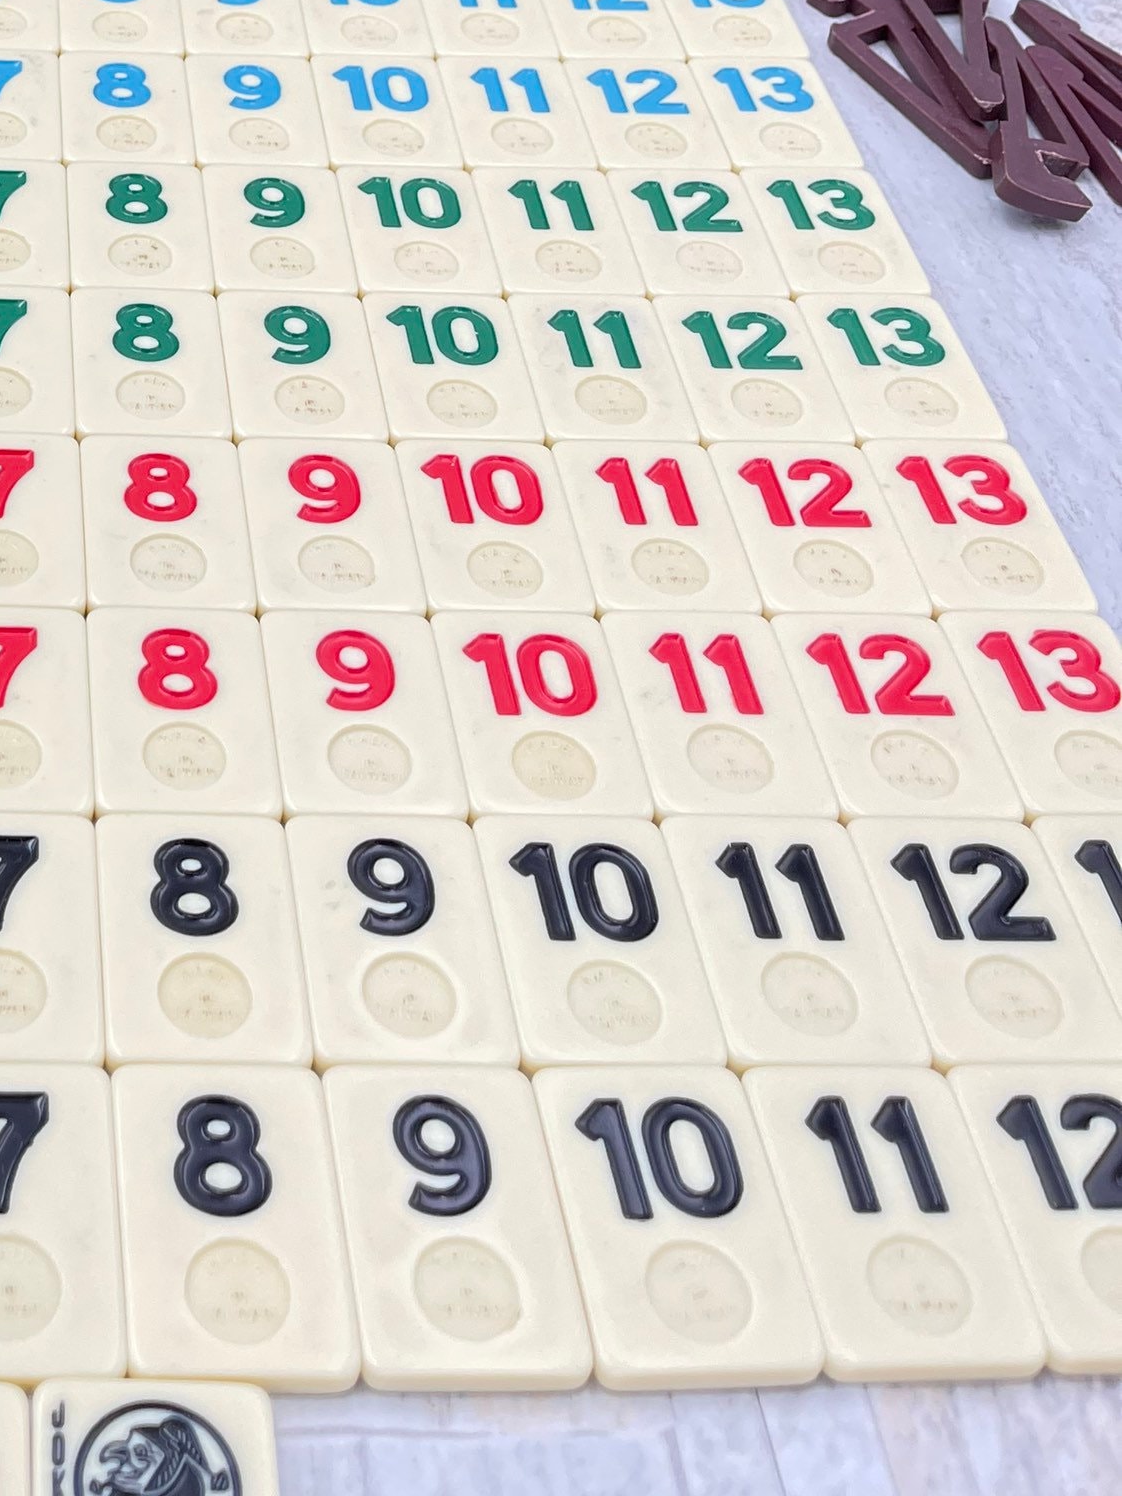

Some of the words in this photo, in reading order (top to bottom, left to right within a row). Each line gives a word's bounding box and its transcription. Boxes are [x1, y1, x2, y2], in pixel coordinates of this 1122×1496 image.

[92, 62, 153, 109] 8
[222, 64, 283, 111] 9
[332, 64, 430, 113] 10
[470, 66, 551, 114] 11
[586, 68, 690, 116] 12
[713, 65, 815, 114] 13
[104, 172, 169, 225] 8
[242, 176, 307, 229] 9
[357, 176, 463, 230] 10
[507, 178, 595, 232] 11
[630, 180, 744, 234] 12
[766, 178, 877, 232] 13
[111, 302, 181, 363] 8
[263, 304, 332, 366] 9
[385, 304, 500, 367] 10
[548, 308, 642, 370] 11
[681, 310, 804, 371] 12
[826, 306, 947, 368] 13
[122, 451, 199, 524] 8
[286, 453, 363, 526] 9
[419, 453, 545, 527] 10
[594, 456, 700, 528] 11
[737, 456, 873, 529] 12
[895, 453, 1029, 527] 13
[136, 626, 220, 712] 8
[314, 628, 397, 713] 9
[461, 631, 599, 718] 10
[647, 631, 765, 717] 11
[804, 632, 956, 718] 12
[975, 628, 1122, 714] 13
[148, 837, 240, 938] 8
[345, 837, 437, 938] 9
[507, 841, 660, 944] 10
[714, 841, 847, 943] 11
[889, 842, 1058, 943] 12
[172, 1093, 274, 1219] 8
[391, 1094, 493, 1218] 9
[573, 1096, 745, 1221] 10
[804, 1095, 950, 1215] 11
[995, 1093, 1122, 1212] 12
